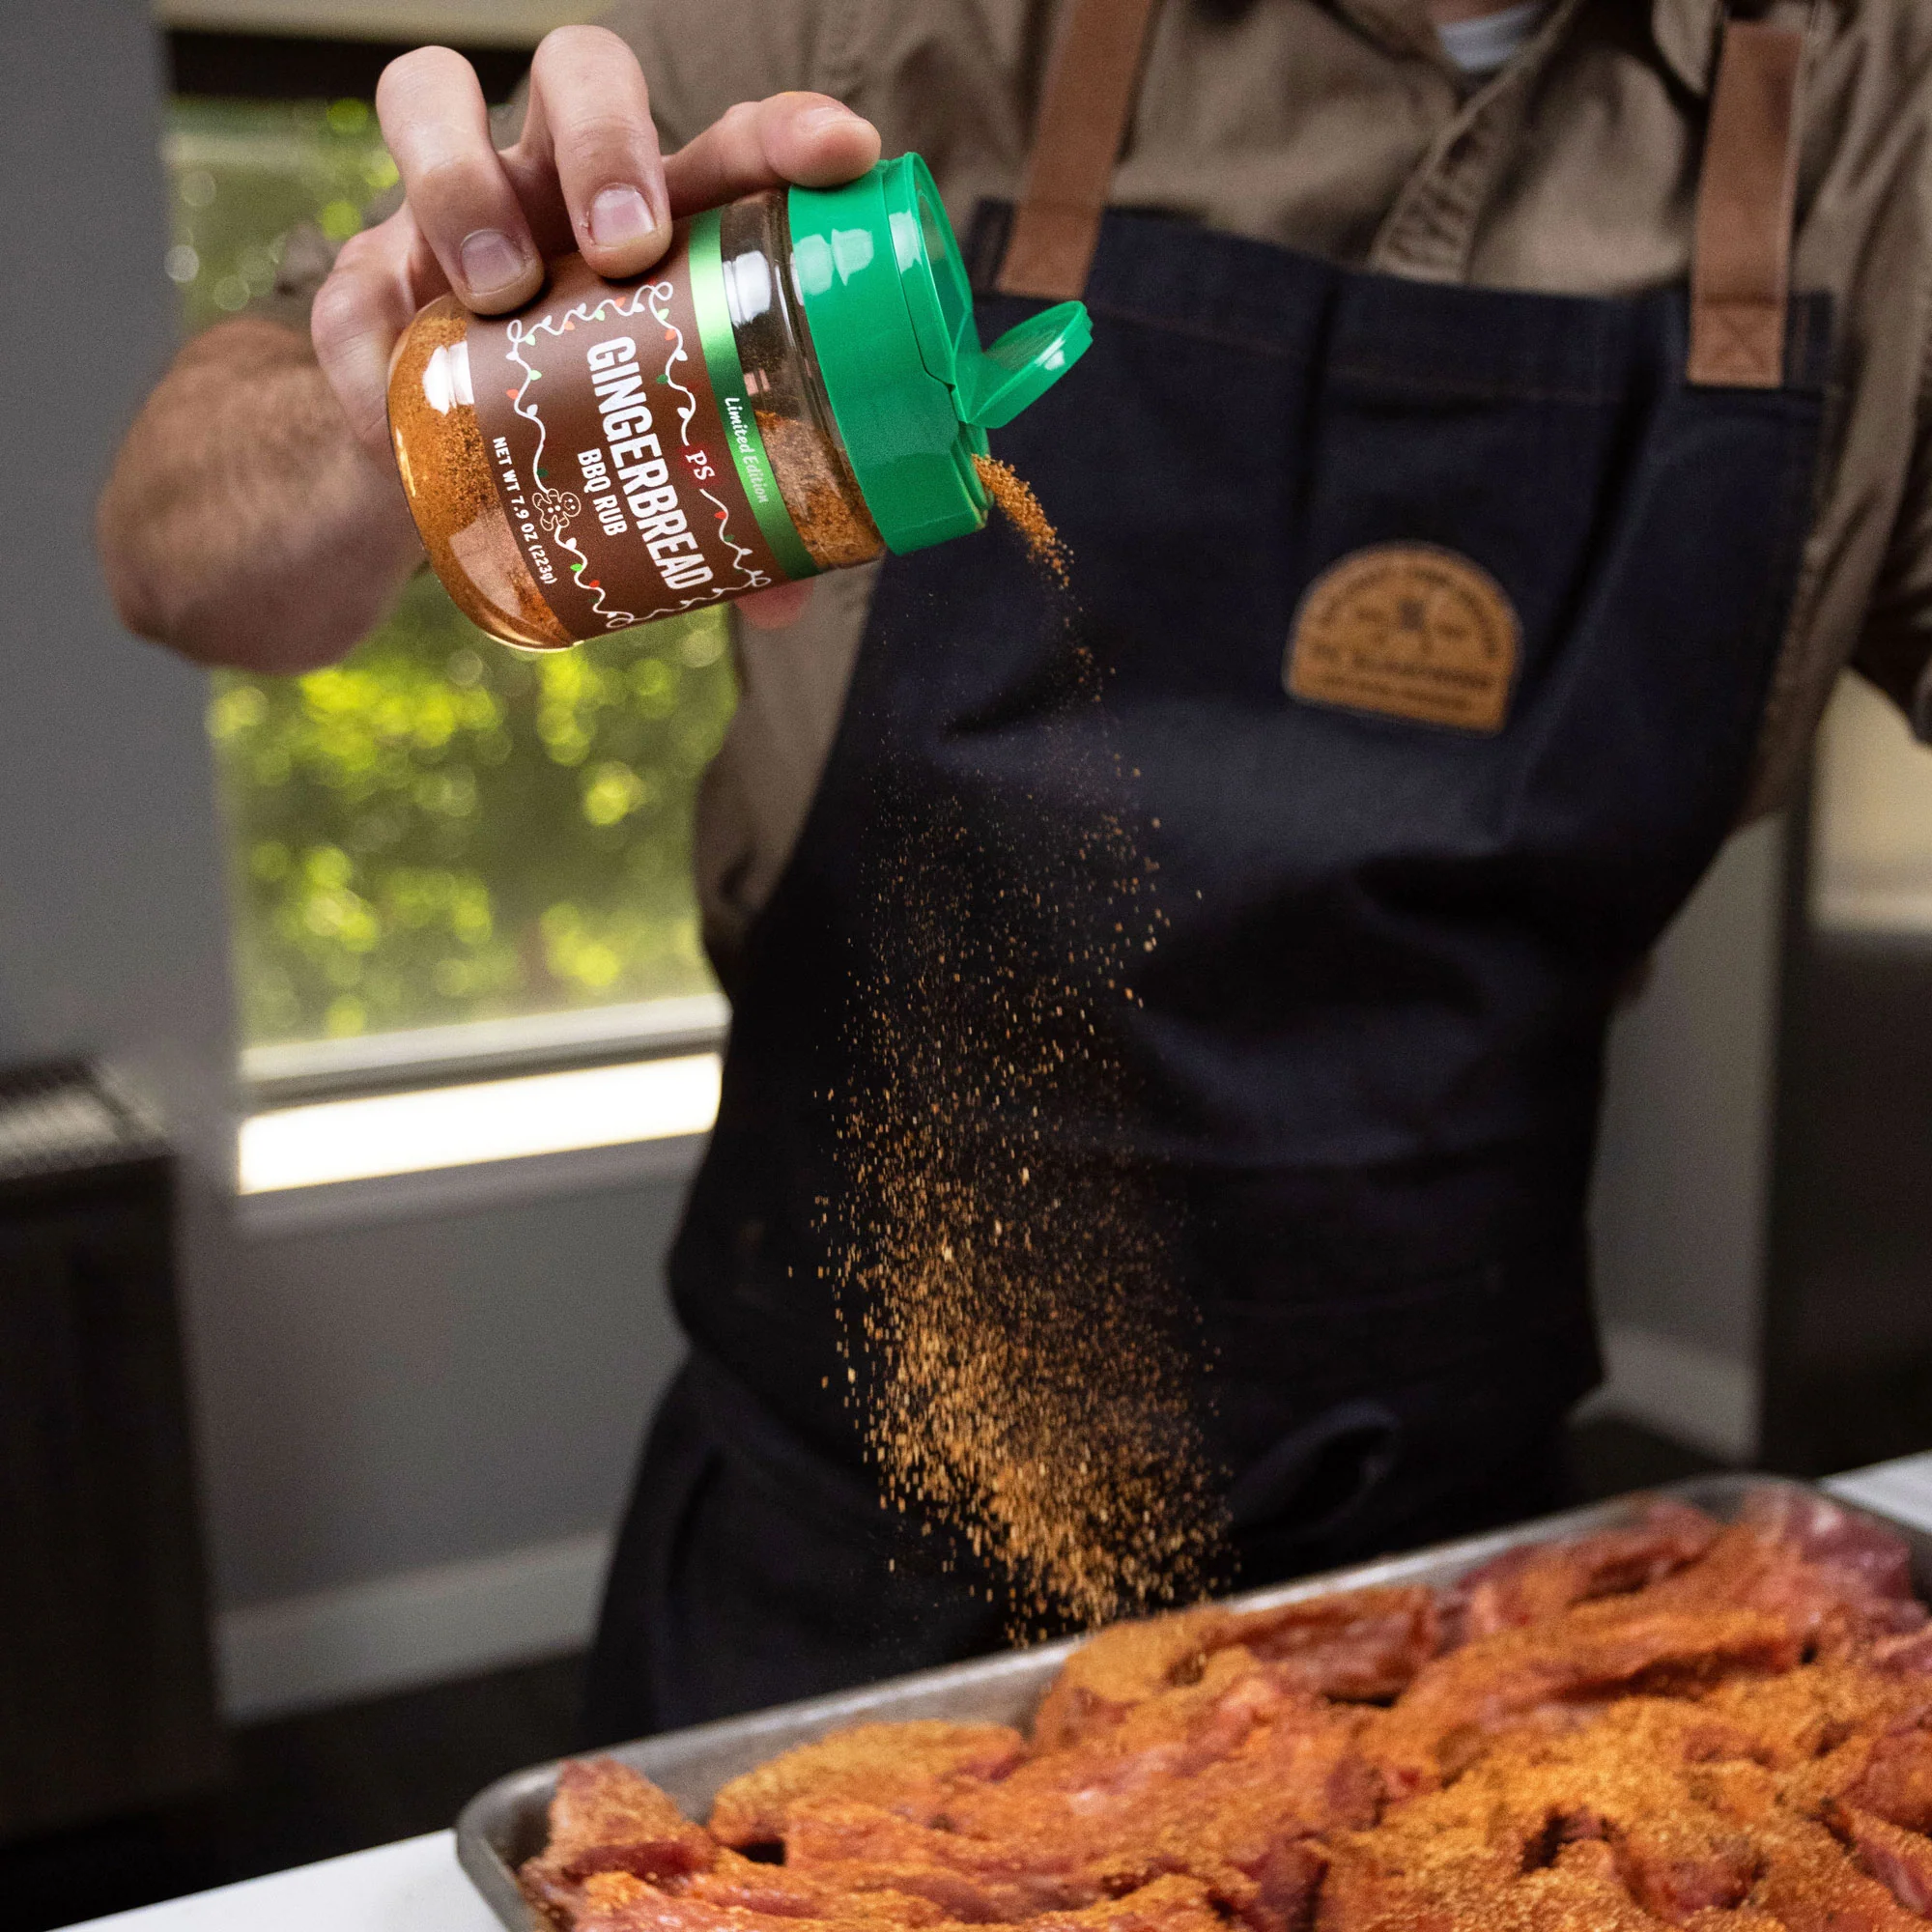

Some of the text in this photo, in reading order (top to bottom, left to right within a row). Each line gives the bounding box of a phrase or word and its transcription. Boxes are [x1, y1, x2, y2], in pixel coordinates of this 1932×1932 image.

[578, 448, 628, 536] BBQ RUB
[586, 336, 714, 589] GINGERBREAD
[685, 450, 715, 480] PS
[724, 397, 769, 503] Limited Edition
[493, 437, 557, 584] NET WT 7.9 OZ (223g)
